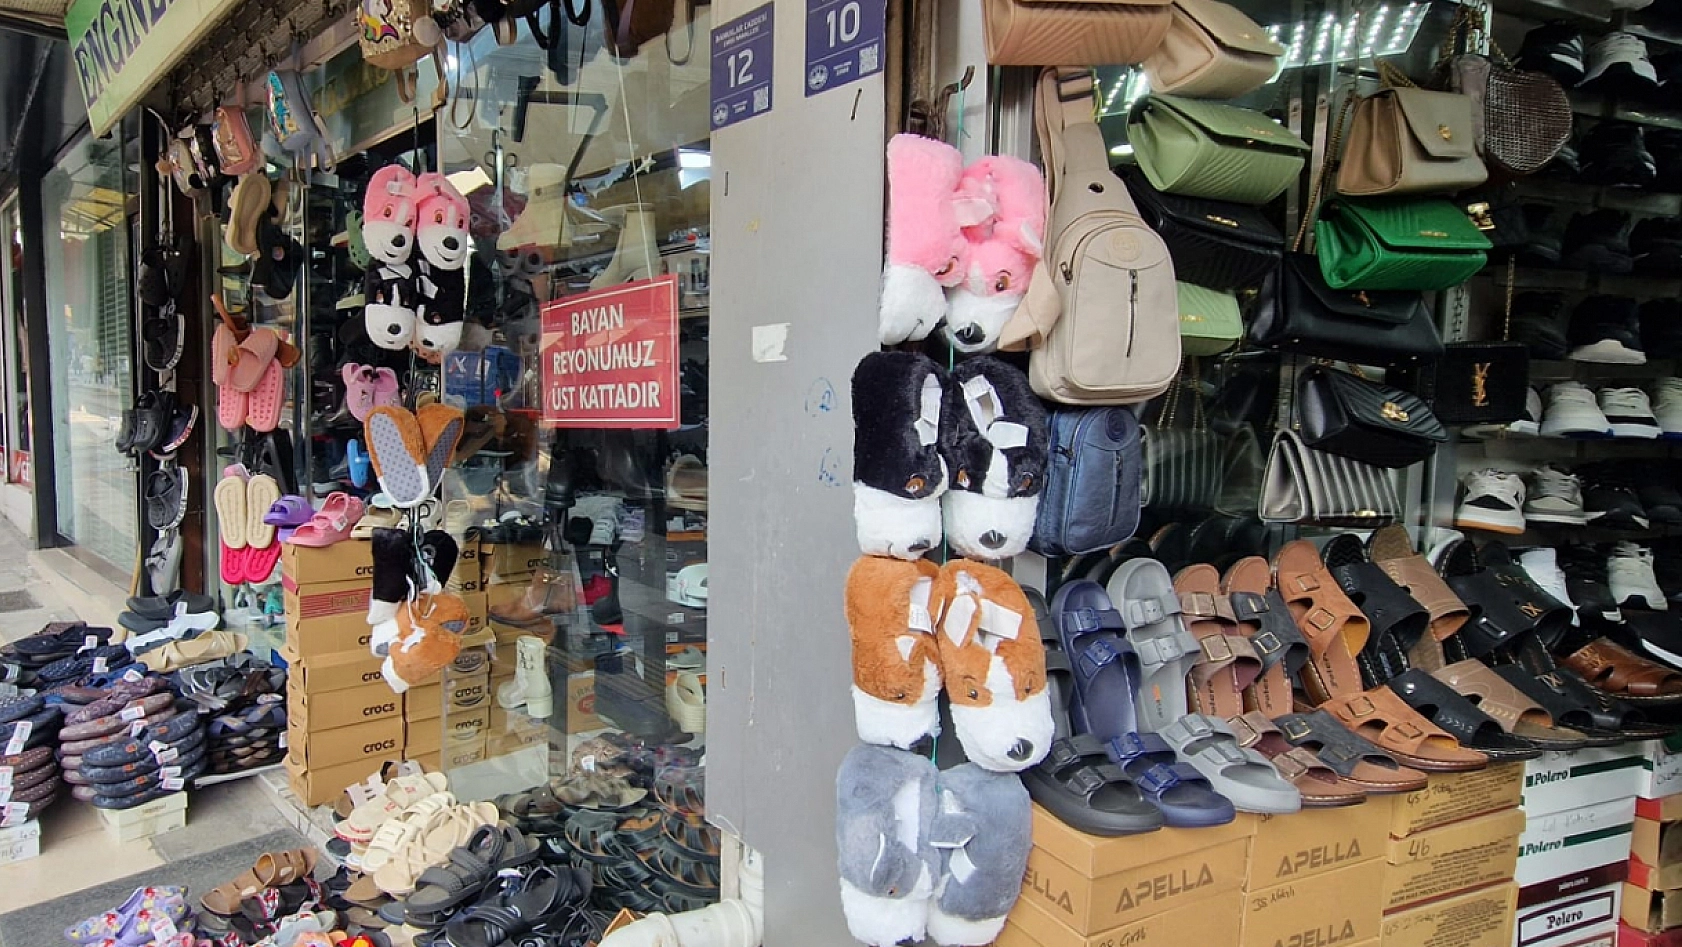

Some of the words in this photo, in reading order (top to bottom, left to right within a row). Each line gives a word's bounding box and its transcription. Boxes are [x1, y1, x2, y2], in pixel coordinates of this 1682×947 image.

[827, 2, 860, 48] 10
[727, 49, 754, 88] 12
[571, 303, 624, 336] BAYAN
[553, 340, 656, 375] REYONUMUZ
[552, 381, 575, 411] ÜST
[579, 380, 661, 409] KATTADIR
[355, 565, 373, 575] cro
[361, 671, 384, 682] cro
[455, 685, 482, 698] crocs
[363, 703, 395, 716] crocs
[455, 718, 483, 731] crocs
[363, 739, 395, 753] crocs
[1533, 770, 1568, 786] Polero
[1525, 840, 1562, 857] Polero
[1276, 838, 1362, 879] APELLA
[1022, 865, 1074, 915] ELLA
[1114, 862, 1214, 914] APELLA
[1546, 910, 1584, 929] Polero
